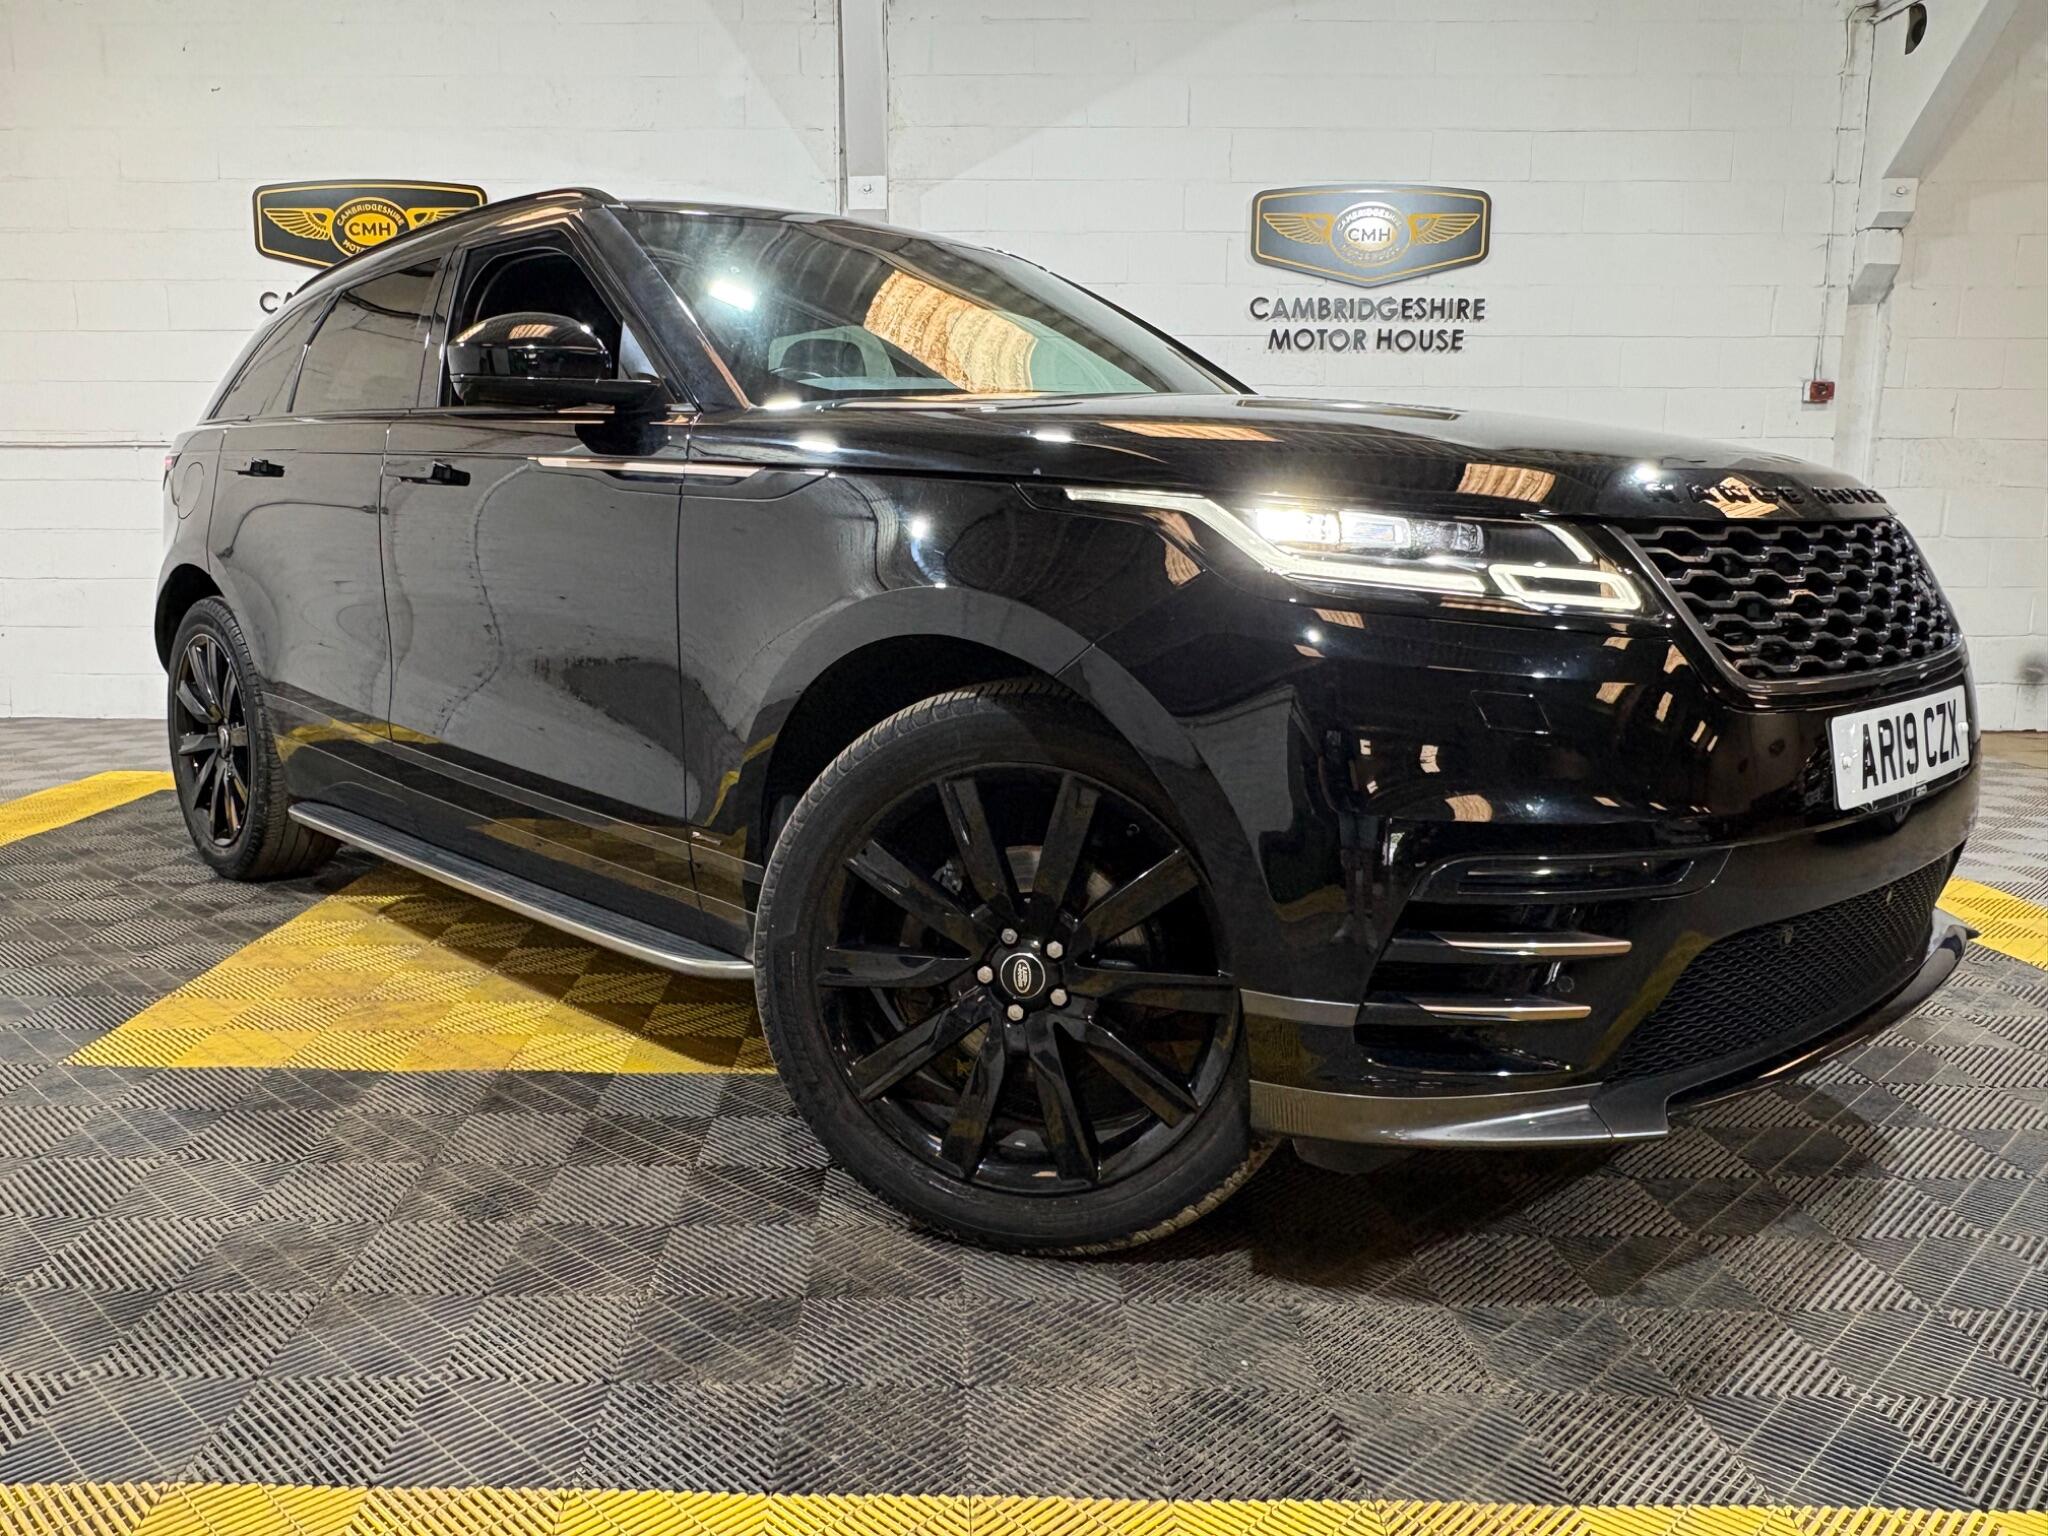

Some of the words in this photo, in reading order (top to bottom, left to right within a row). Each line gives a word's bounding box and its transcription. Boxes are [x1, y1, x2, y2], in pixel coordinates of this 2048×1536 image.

[337, 203, 405, 227] CAMBRIDGESHIRE
[348, 221, 391, 236] CMH
[1347, 227, 1391, 242] CMH
[342, 239, 366, 255] MOT
[1249, 297, 1486, 321] CAMBRIDGESHIRE
[1267, 328, 1367, 351] MOTOR
[1376, 328, 1465, 351] HOUSE
[1862, 712, 1920, 790] AR19
[1923, 699, 1960, 768] CZX
